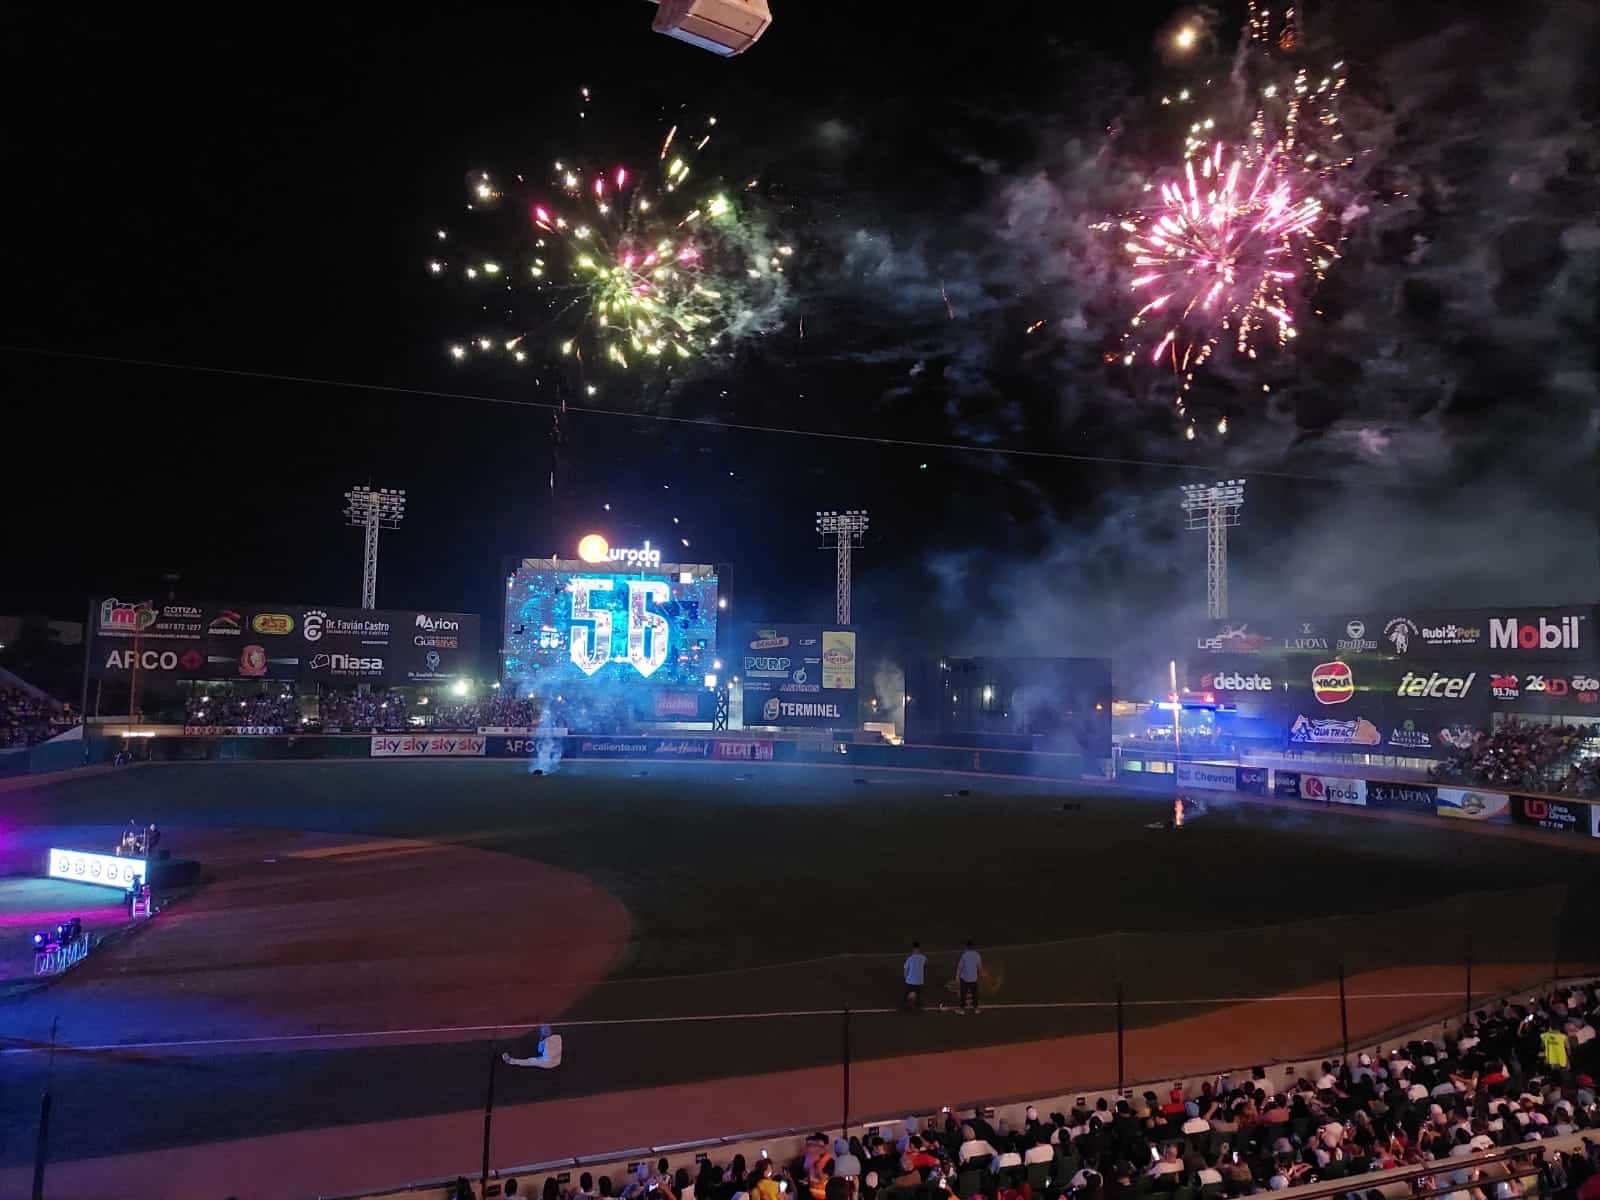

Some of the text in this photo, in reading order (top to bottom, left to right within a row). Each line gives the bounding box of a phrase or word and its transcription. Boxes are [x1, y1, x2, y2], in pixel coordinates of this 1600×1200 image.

[364, 621, 390, 631] Castro
[423, 616, 459, 631] Arion
[1489, 616, 1580, 649] Mobil
[106, 650, 178, 670] ARCO
[1213, 671, 1273, 691] debate
[1316, 678, 1351, 689] YAQUI
[1396, 672, 1477, 698] telcel
[780, 702, 841, 718] TERMINEL
[374, 738, 483, 753] sky sky sky sky
[1194, 770, 1235, 785] Chevron
